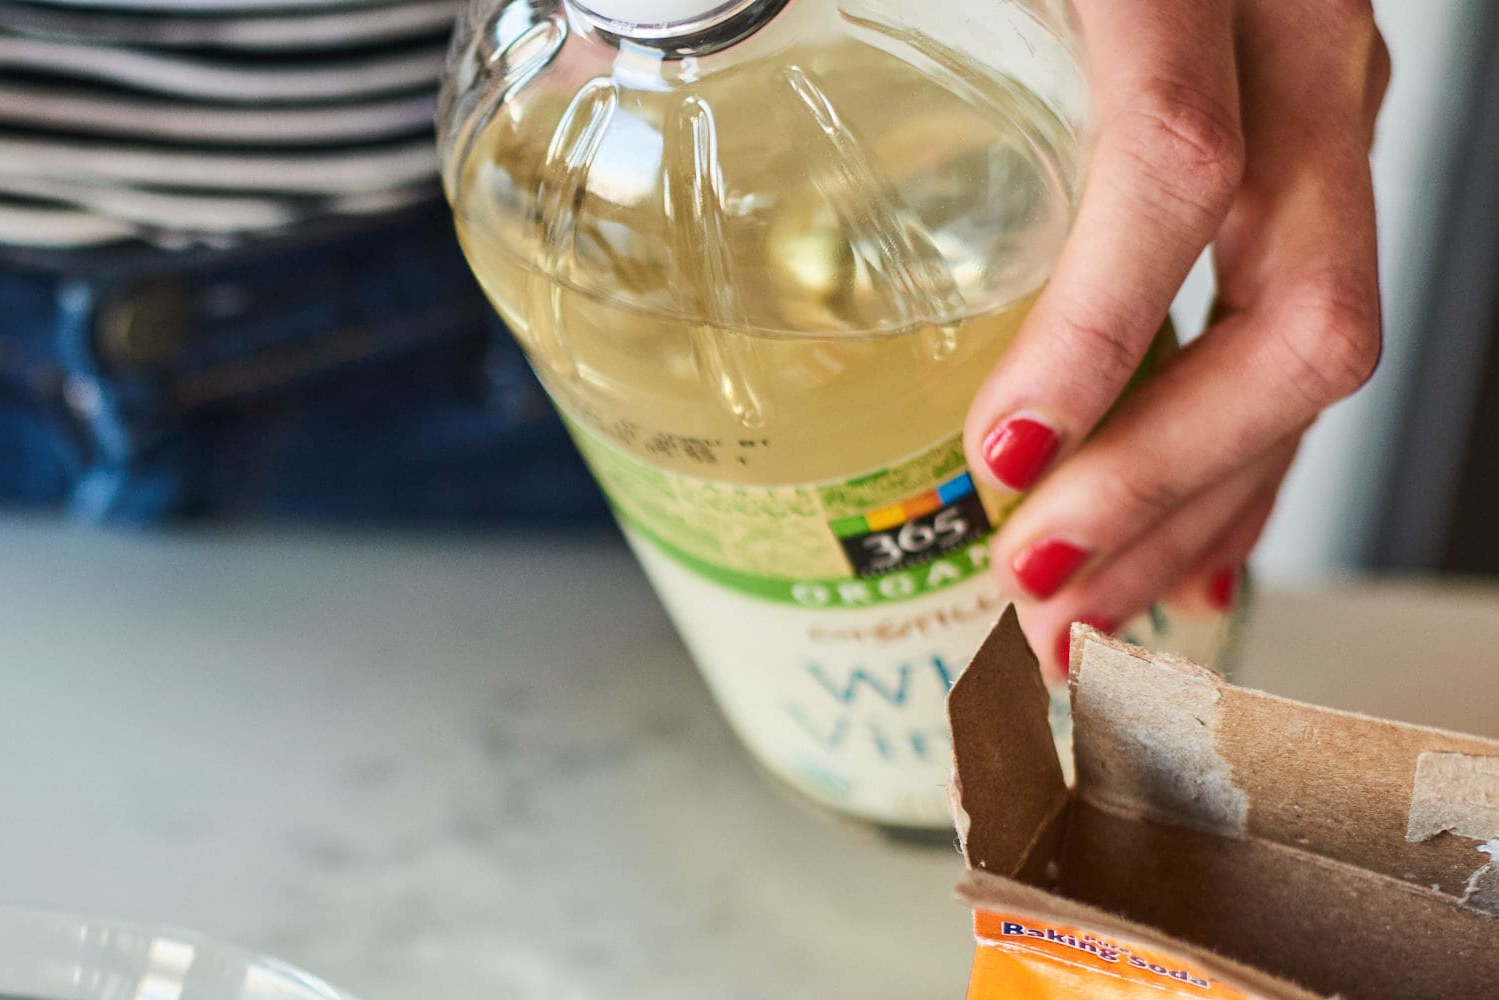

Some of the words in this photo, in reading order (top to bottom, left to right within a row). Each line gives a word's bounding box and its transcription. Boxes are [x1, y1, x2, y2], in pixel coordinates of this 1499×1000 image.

[862, 505, 970, 570] 365
[790, 544, 990, 606] ORGAN
[1001, 921, 1121, 962] Baking
[1127, 954, 1210, 989] Soda
[1082, 934, 1131, 954] Pure
